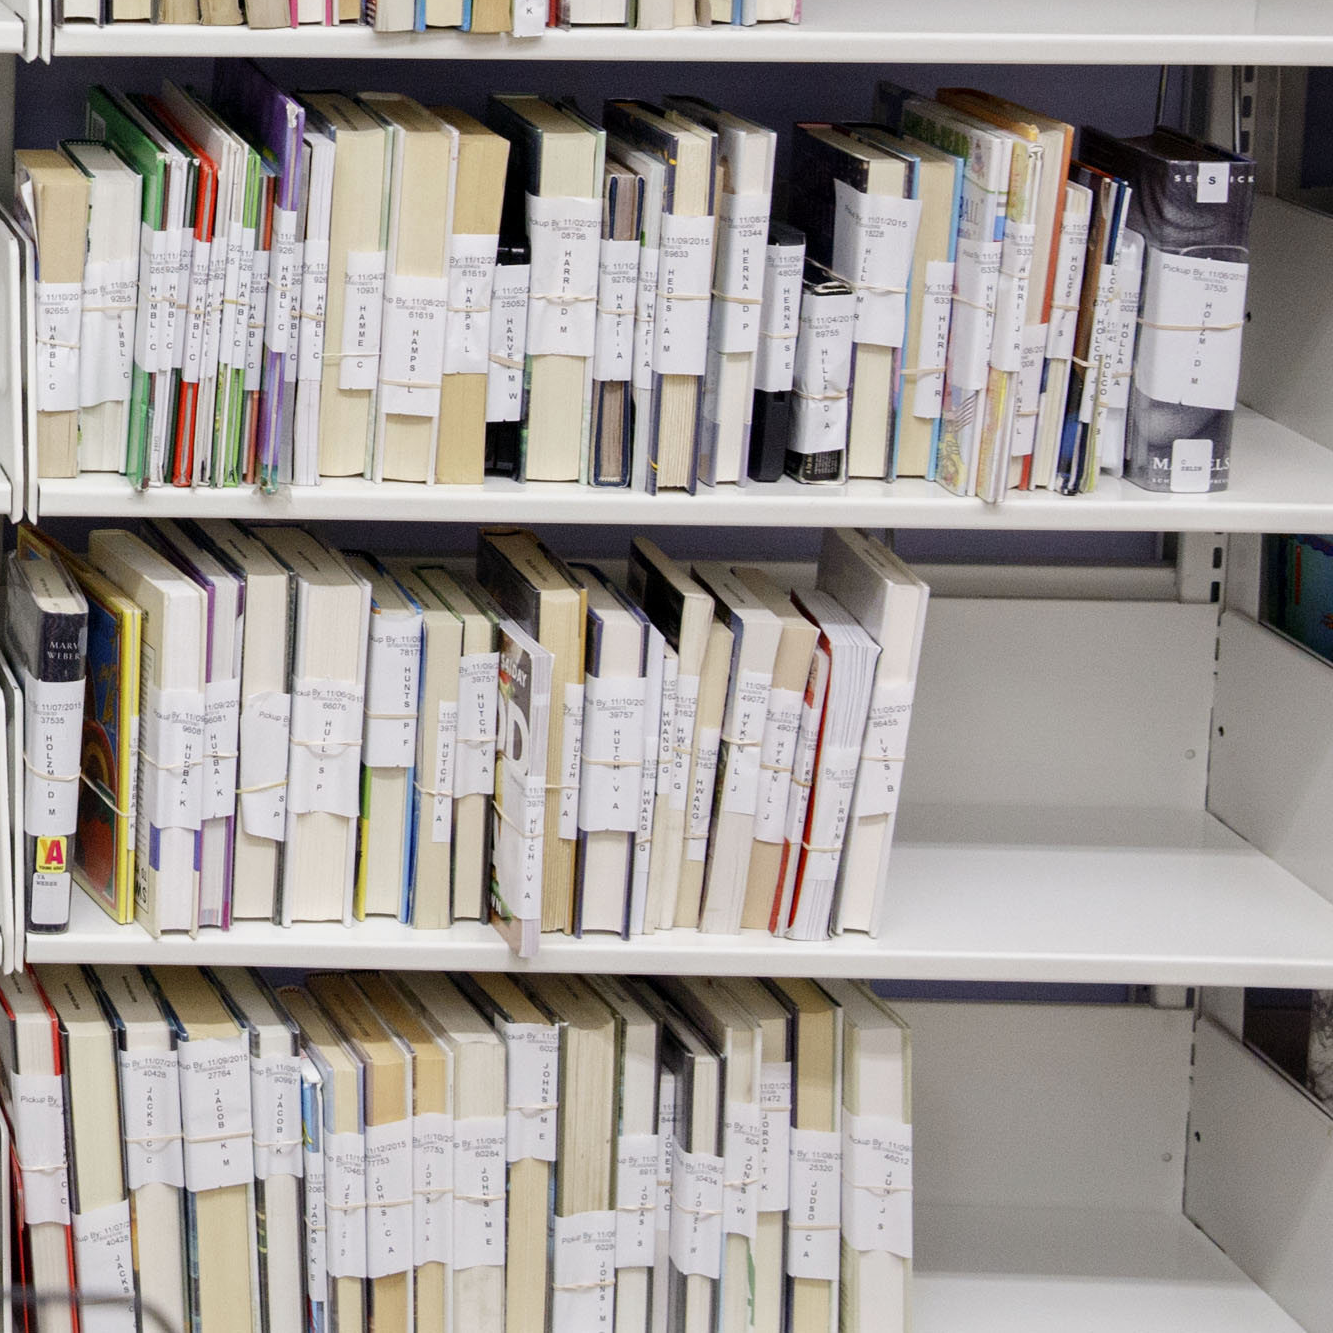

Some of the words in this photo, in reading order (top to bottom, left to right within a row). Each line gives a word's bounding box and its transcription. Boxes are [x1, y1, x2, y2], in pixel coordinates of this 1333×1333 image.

[1208, 176, 1217, 185] S
[45, 306, 69, 314] 92655
[47, 651, 81, 660] WEBER
[41, 716, 65, 724] 37535
[39, 839, 64, 865] YA
